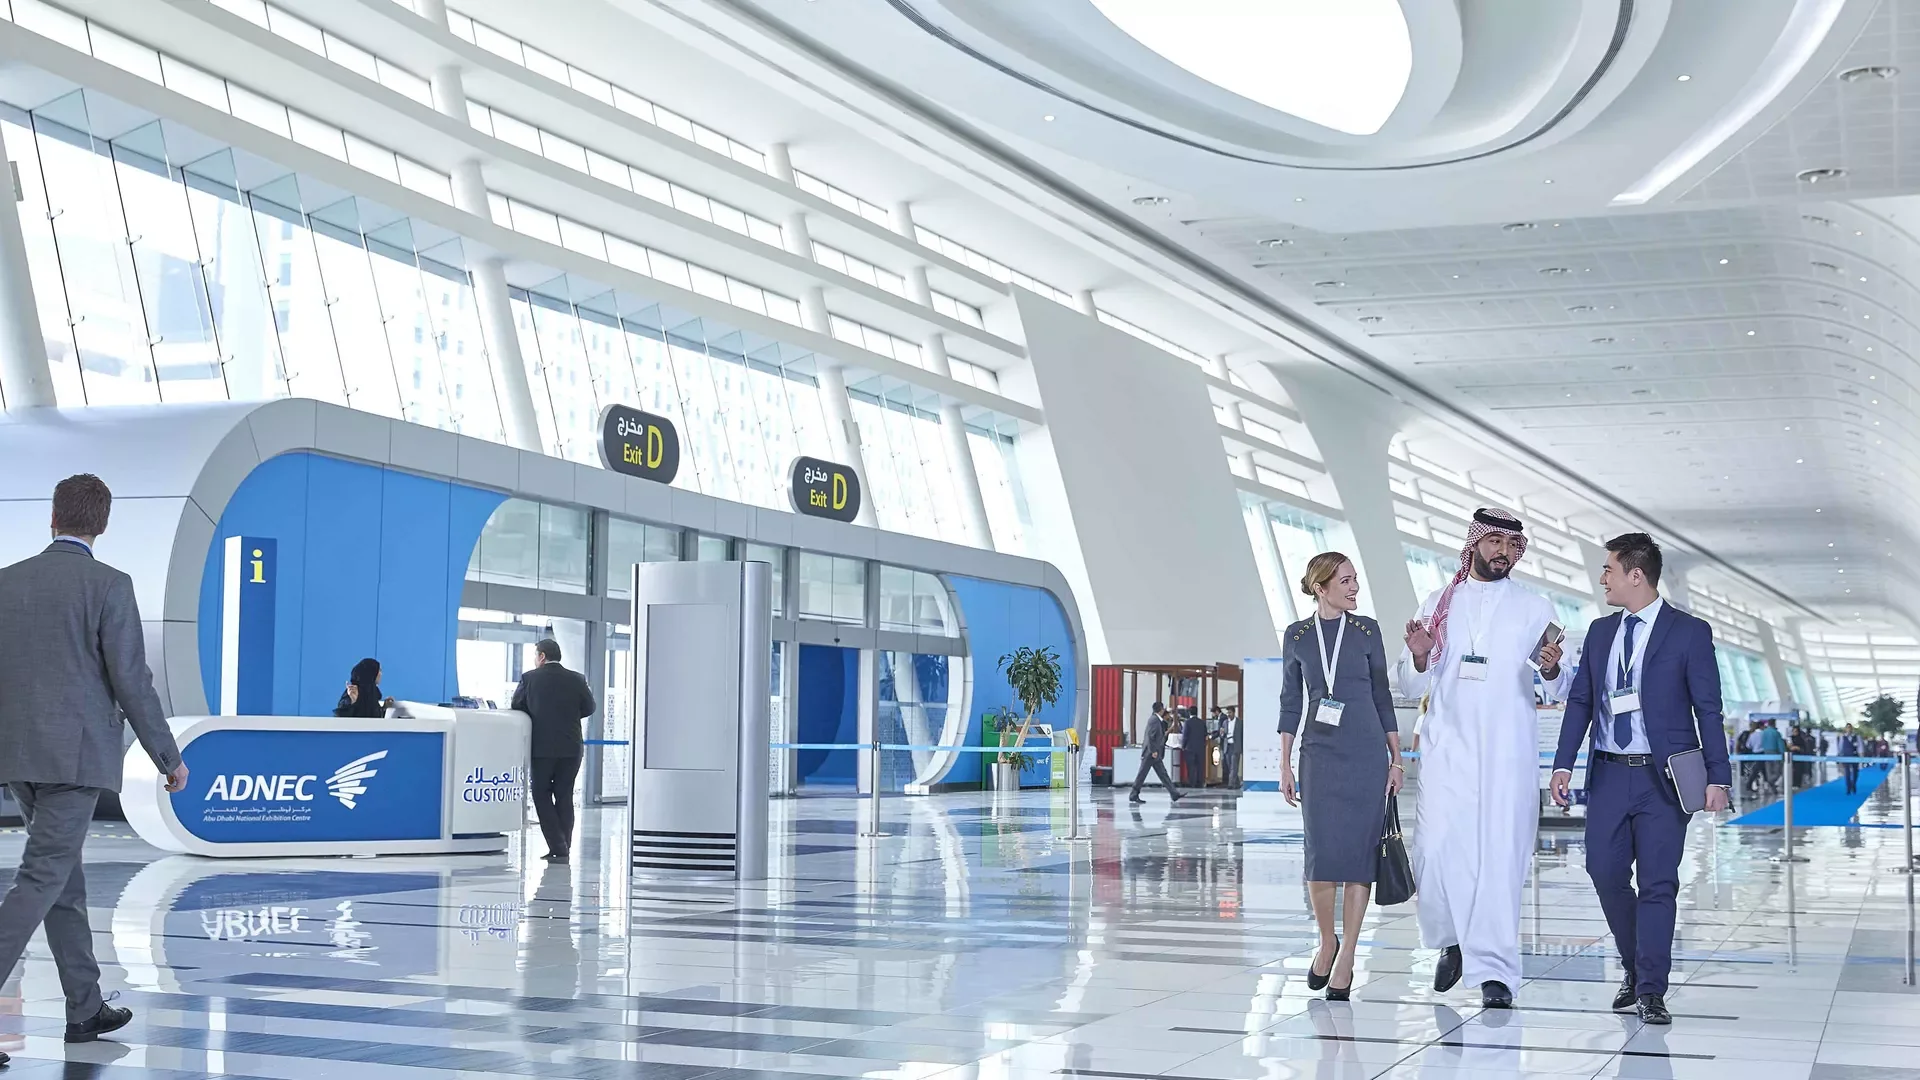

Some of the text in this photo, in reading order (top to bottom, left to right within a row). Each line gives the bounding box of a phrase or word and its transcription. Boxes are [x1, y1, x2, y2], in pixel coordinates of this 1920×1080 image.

[617, 416, 643, 437] مخرج
[623, 424, 663, 469] Exit D
[804, 466, 828, 484] مخرج
[810, 472, 848, 510] Exit D
[204, 774, 318, 801] ADNEC
[291, 814, 312, 822] Centre
